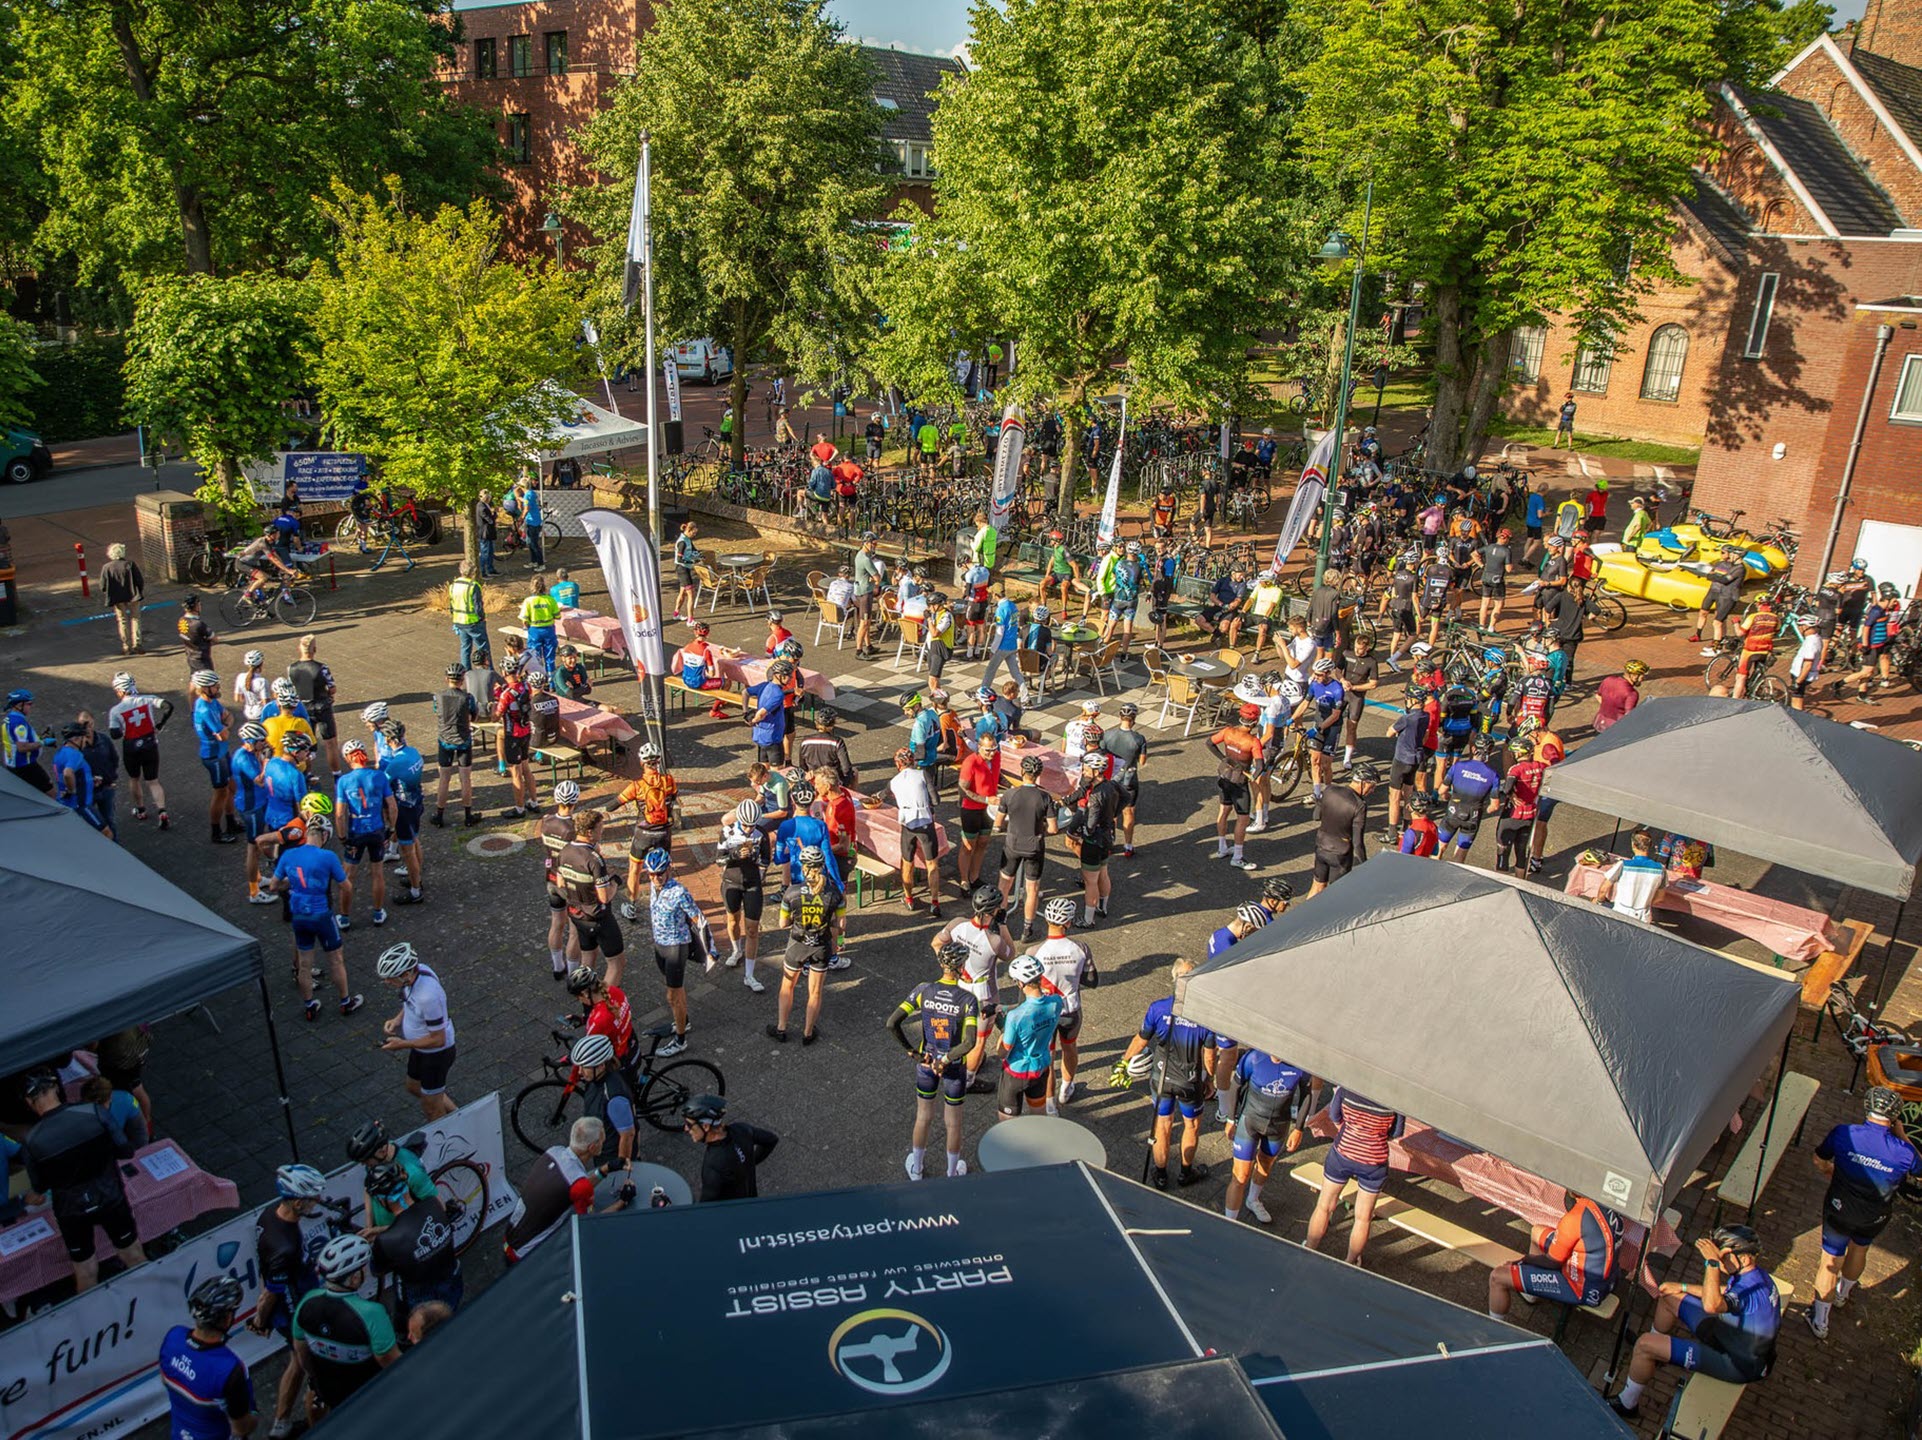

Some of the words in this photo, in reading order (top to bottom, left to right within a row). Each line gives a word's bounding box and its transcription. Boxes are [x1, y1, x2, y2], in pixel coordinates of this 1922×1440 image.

[581, 440, 608, 452] Incasso
[608, 438, 615, 446] &
[615, 434, 639, 445] Advies
[801, 895, 823, 905] LA
[802, 915, 822, 926] DA
[469, 1193, 513, 1224] HREN
[738, 1213, 960, 1254] www.partyassist.nl
[884, 1266, 908, 1276] uw
[913, 1253, 1004, 1272] onbetwist
[727, 1276, 820, 1294] specialist
[827, 1270, 877, 1282] feest
[884, 1265, 1014, 1299] PARTY
[1530, 1273, 1559, 1284] BORCA
[725, 1283, 868, 1318] ASSIST
[46, 1297, 138, 1386] fun!
[171, 1356, 197, 1381] NOAD
